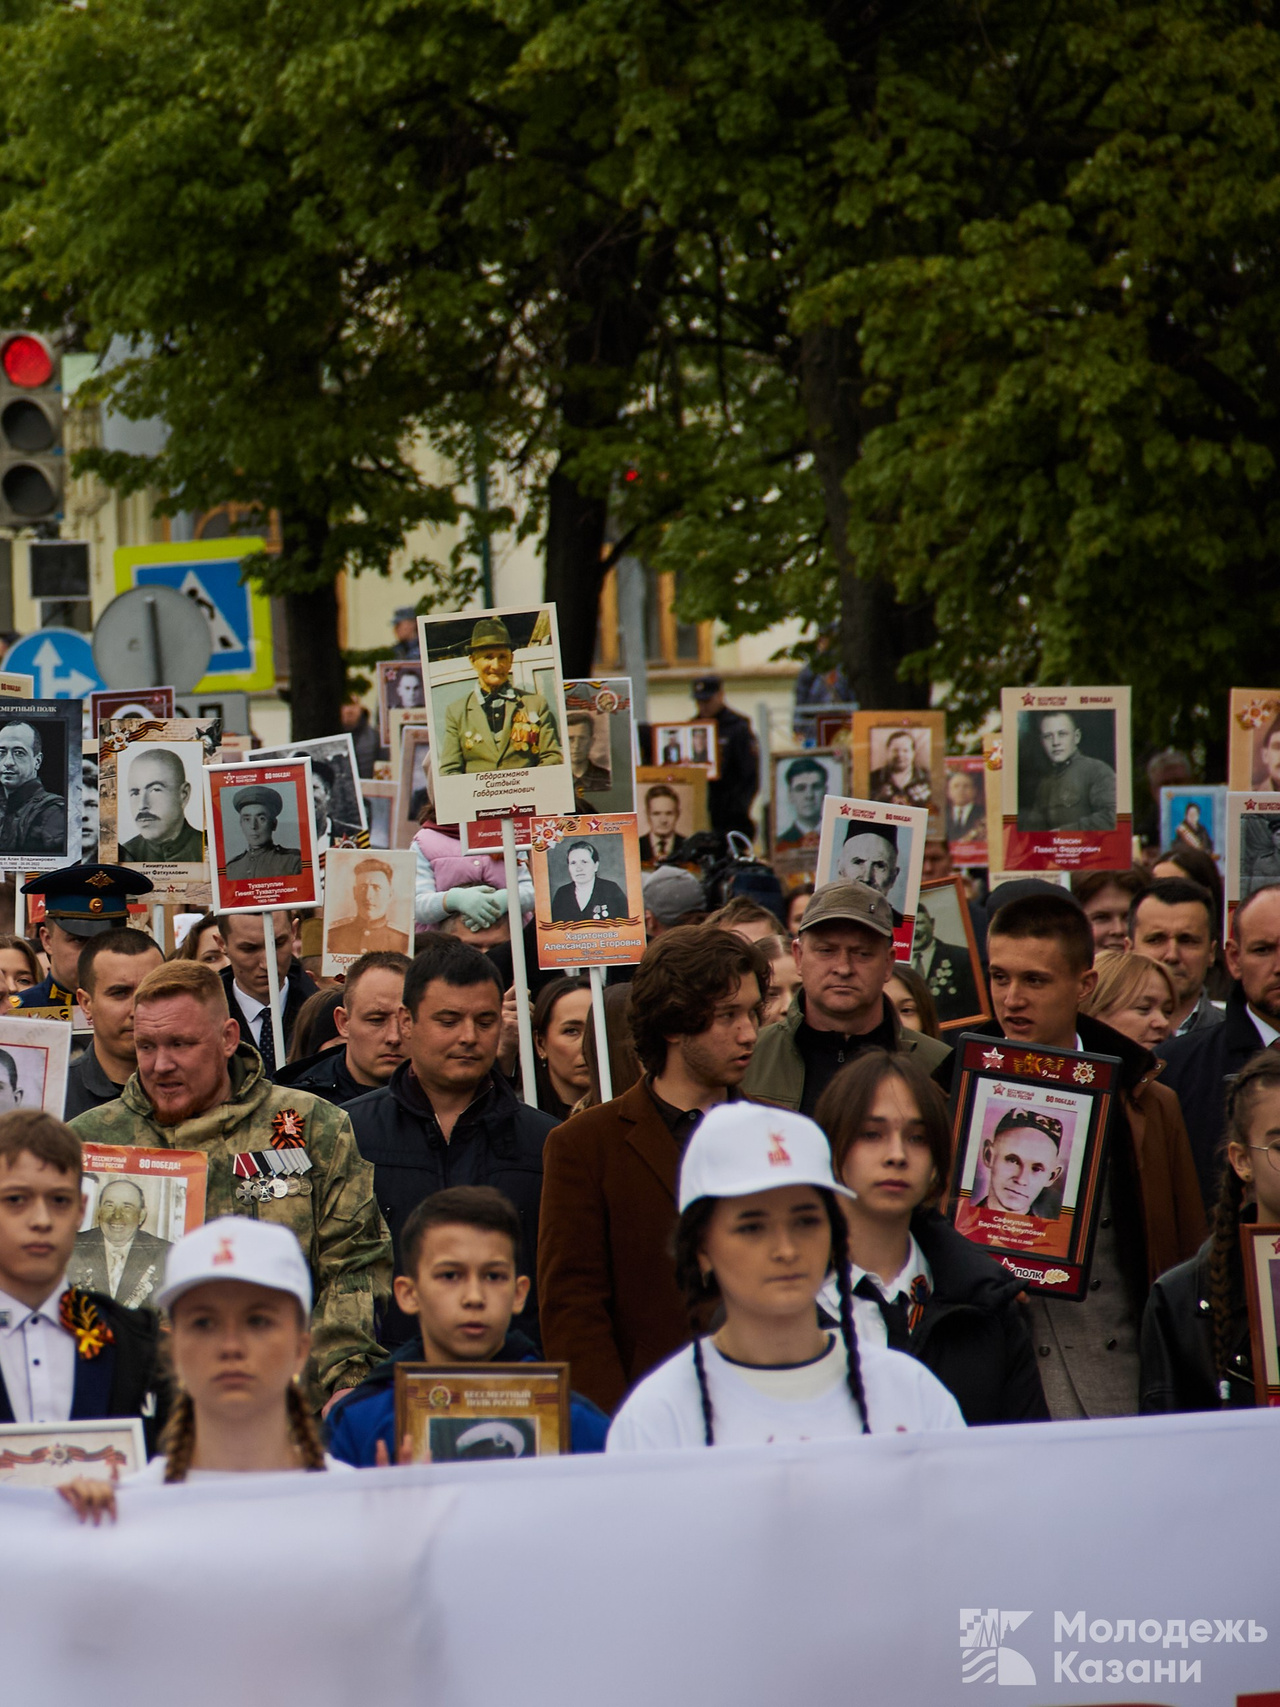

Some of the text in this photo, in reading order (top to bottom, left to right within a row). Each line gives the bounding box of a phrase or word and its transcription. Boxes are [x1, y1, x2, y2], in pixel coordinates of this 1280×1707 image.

[476, 770, 529, 781] Габдрахманов
[485, 779, 520, 788] Ситдыйк
[473, 786, 535, 798] Габдрахманович
[248, 881, 284, 889] Тухватуллин
[256, 887, 298, 896] Тухватуллович
[566, 932, 618, 941] Харитонова
[544, 940, 642, 951] Александра Егоровна
[332, 955, 360, 965] Харит
[92, 1155, 127, 1163] БЕССМЕРТНЫЙ
[151, 1160, 181, 1170] ПОБЕДА!
[993, 1216, 1034, 1227] Сафиуллин
[1015, 1268, 1042, 1279] ПОЛК
[464, 1389, 531, 1399] БЕССМЕРТНЫЙ
[466, 1399, 529, 1407] ПОЛК РОССИИ
